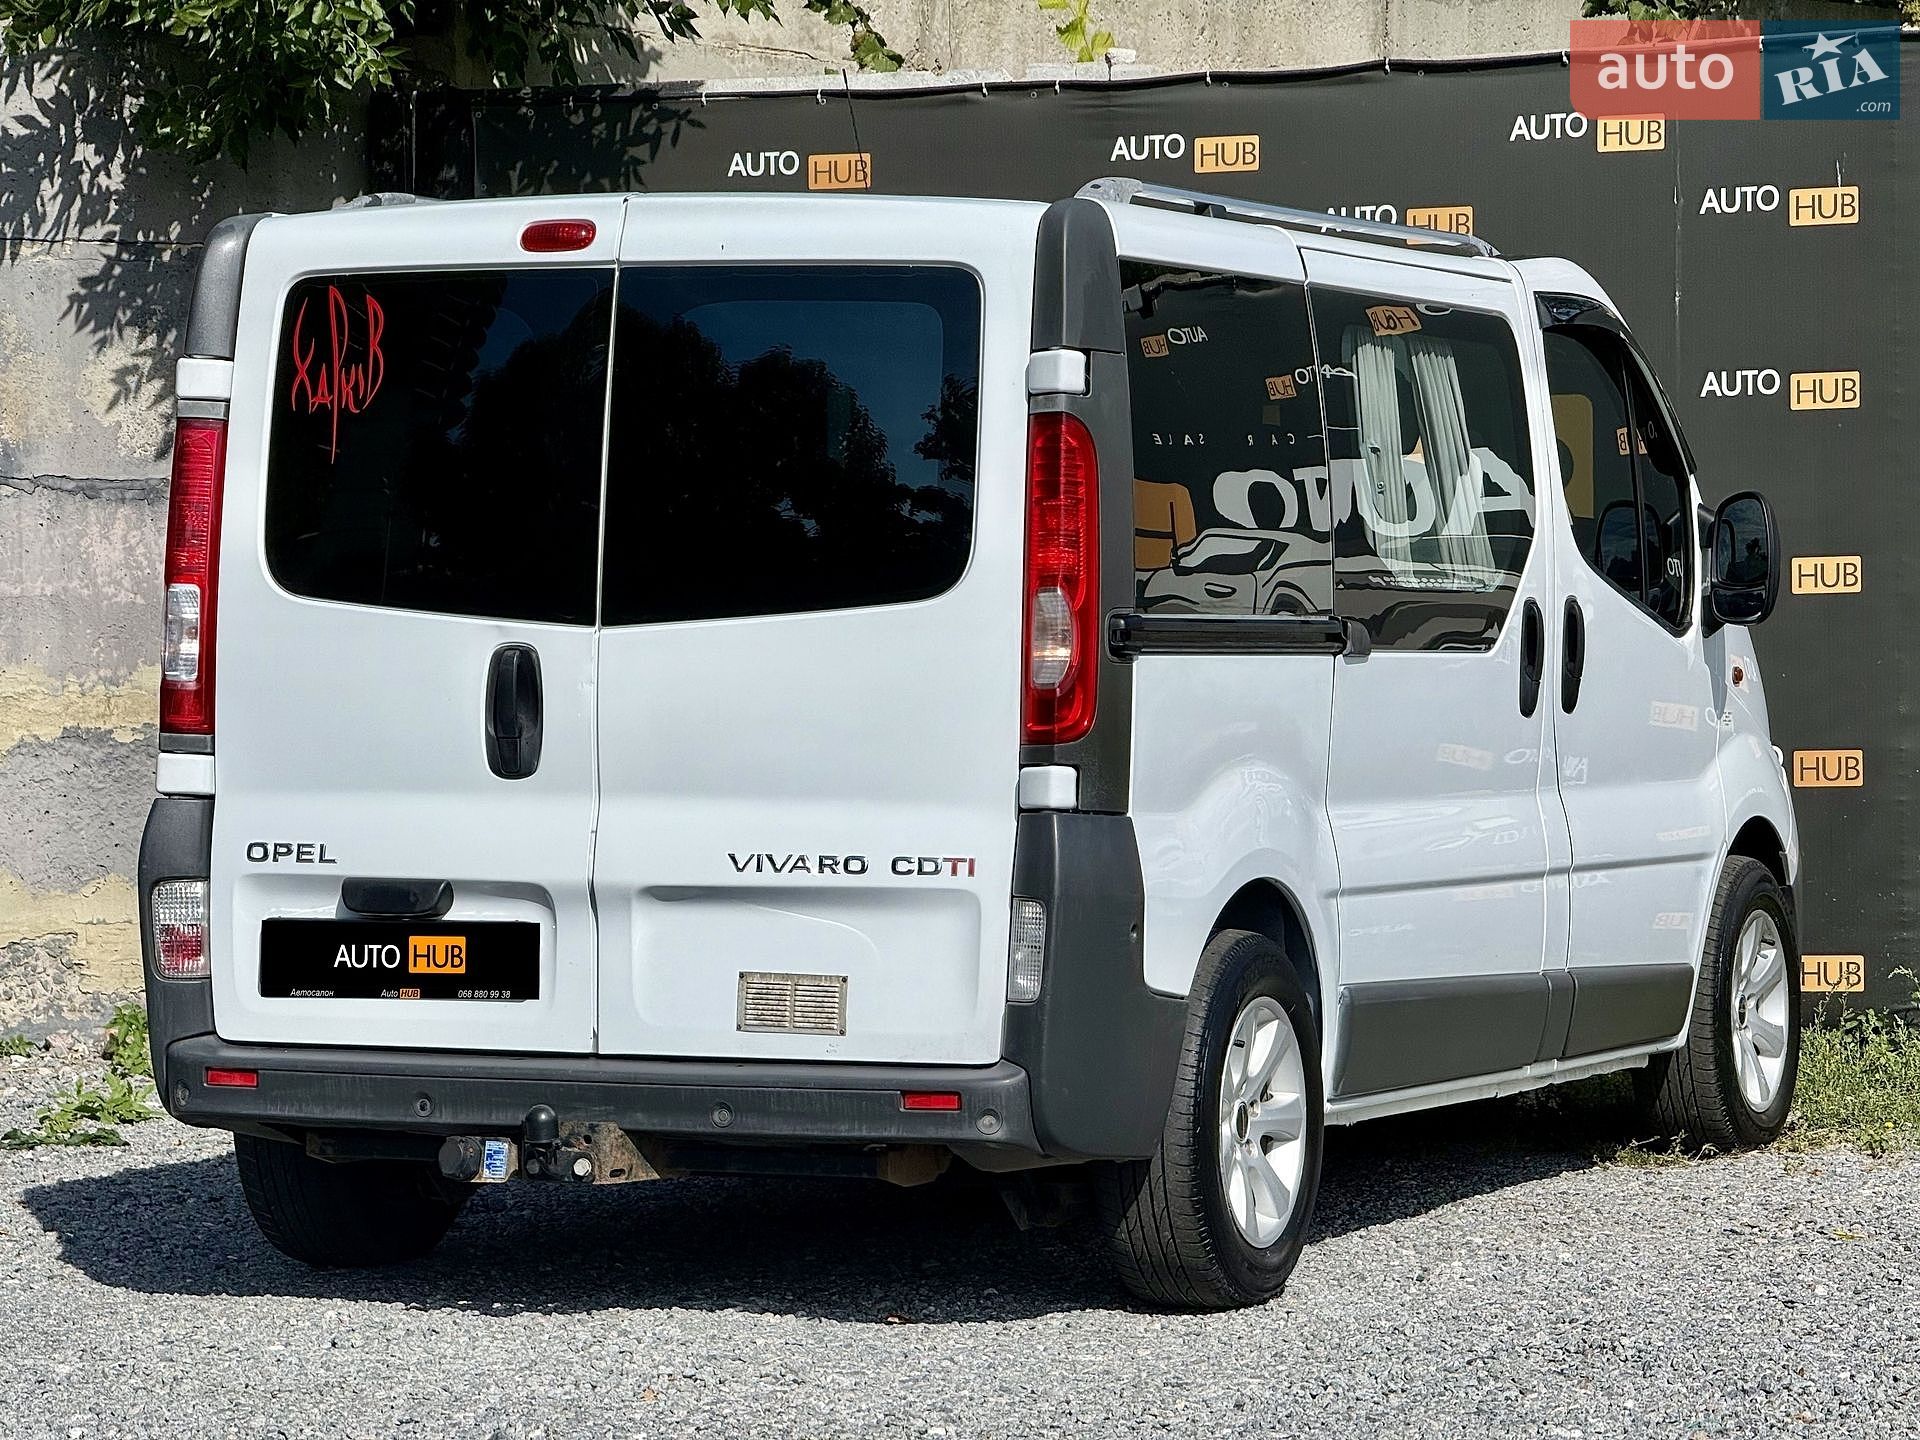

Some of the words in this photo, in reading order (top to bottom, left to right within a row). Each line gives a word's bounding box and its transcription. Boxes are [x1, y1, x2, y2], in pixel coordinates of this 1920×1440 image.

[1509, 111, 1588, 142] AUTO
[1602, 119, 1662, 147] HUB
[1110, 133, 1186, 162] AUTO
[1199, 141, 1257, 168] HUB
[727, 150, 800, 178] AUTO
[813, 158, 869, 184] HUB
[1699, 184, 1780, 215] AUTO
[1794, 192, 1857, 221] HUB
[1700, 368, 1781, 398] AUTO
[1795, 377, 1858, 405] HUB
[1797, 561, 1860, 589] HUB
[1799, 755, 1861, 782] HUB
[245, 841, 338, 865] OPEL
[727, 852, 870, 876] VIVARO
[891, 855, 977, 878] CDTI
[1800, 961, 1862, 988] HUB
